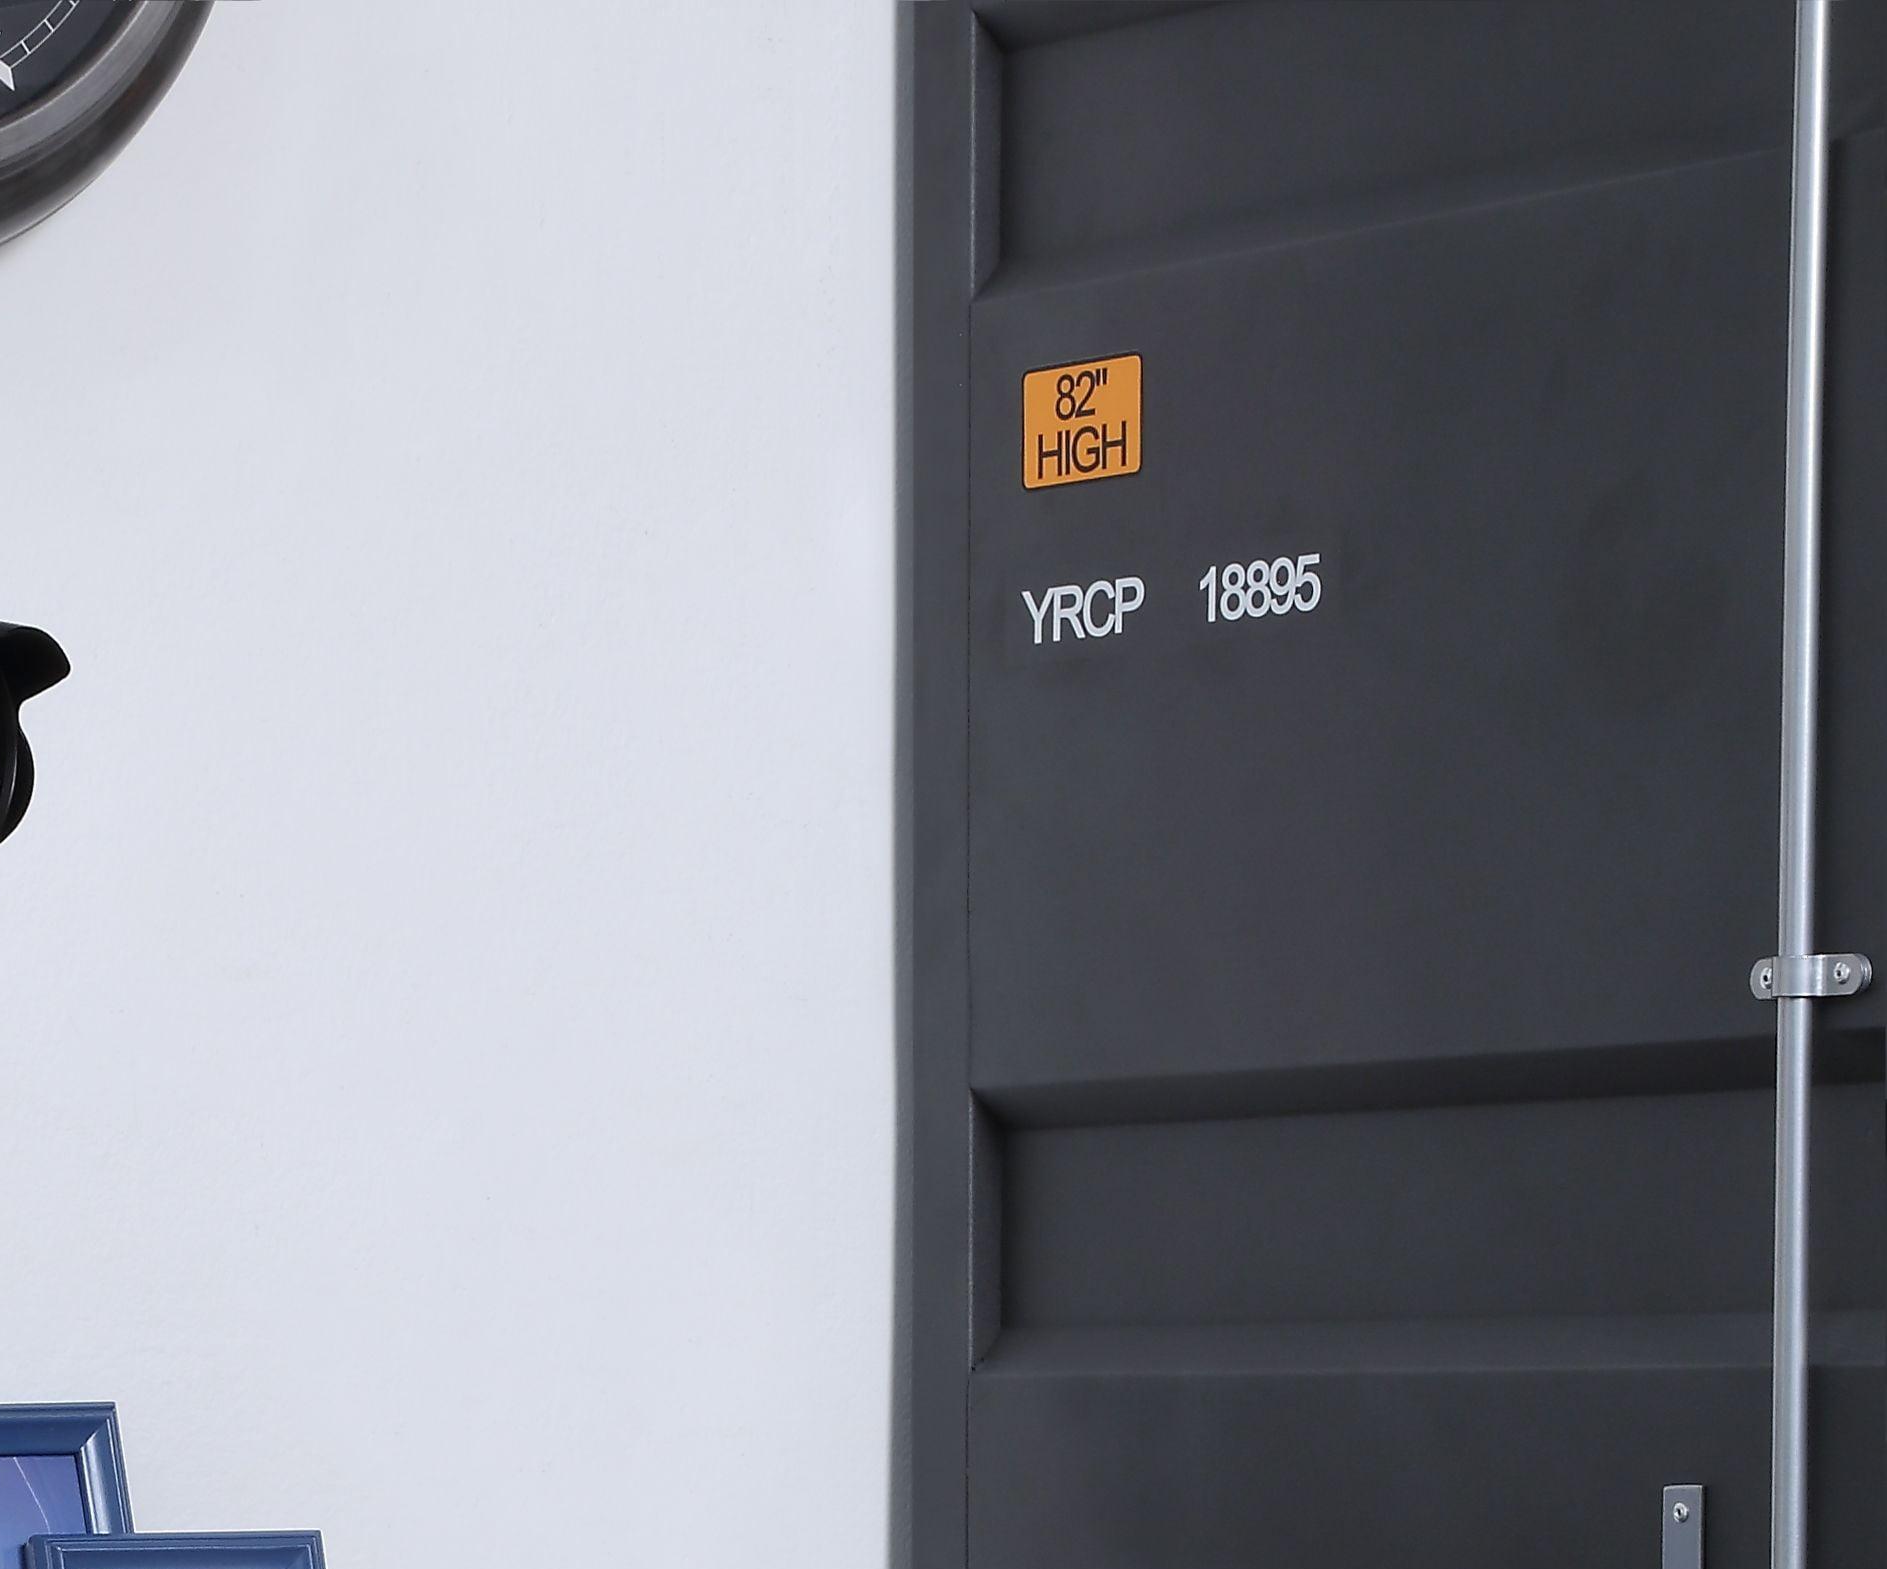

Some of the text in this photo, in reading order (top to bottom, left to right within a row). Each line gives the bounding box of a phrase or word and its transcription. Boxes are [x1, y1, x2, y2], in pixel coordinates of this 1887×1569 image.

[1054, 367, 1108, 422] 82"
[1037, 420, 1127, 480] HIGH
[1021, 552, 1322, 645] YRCP 18895
